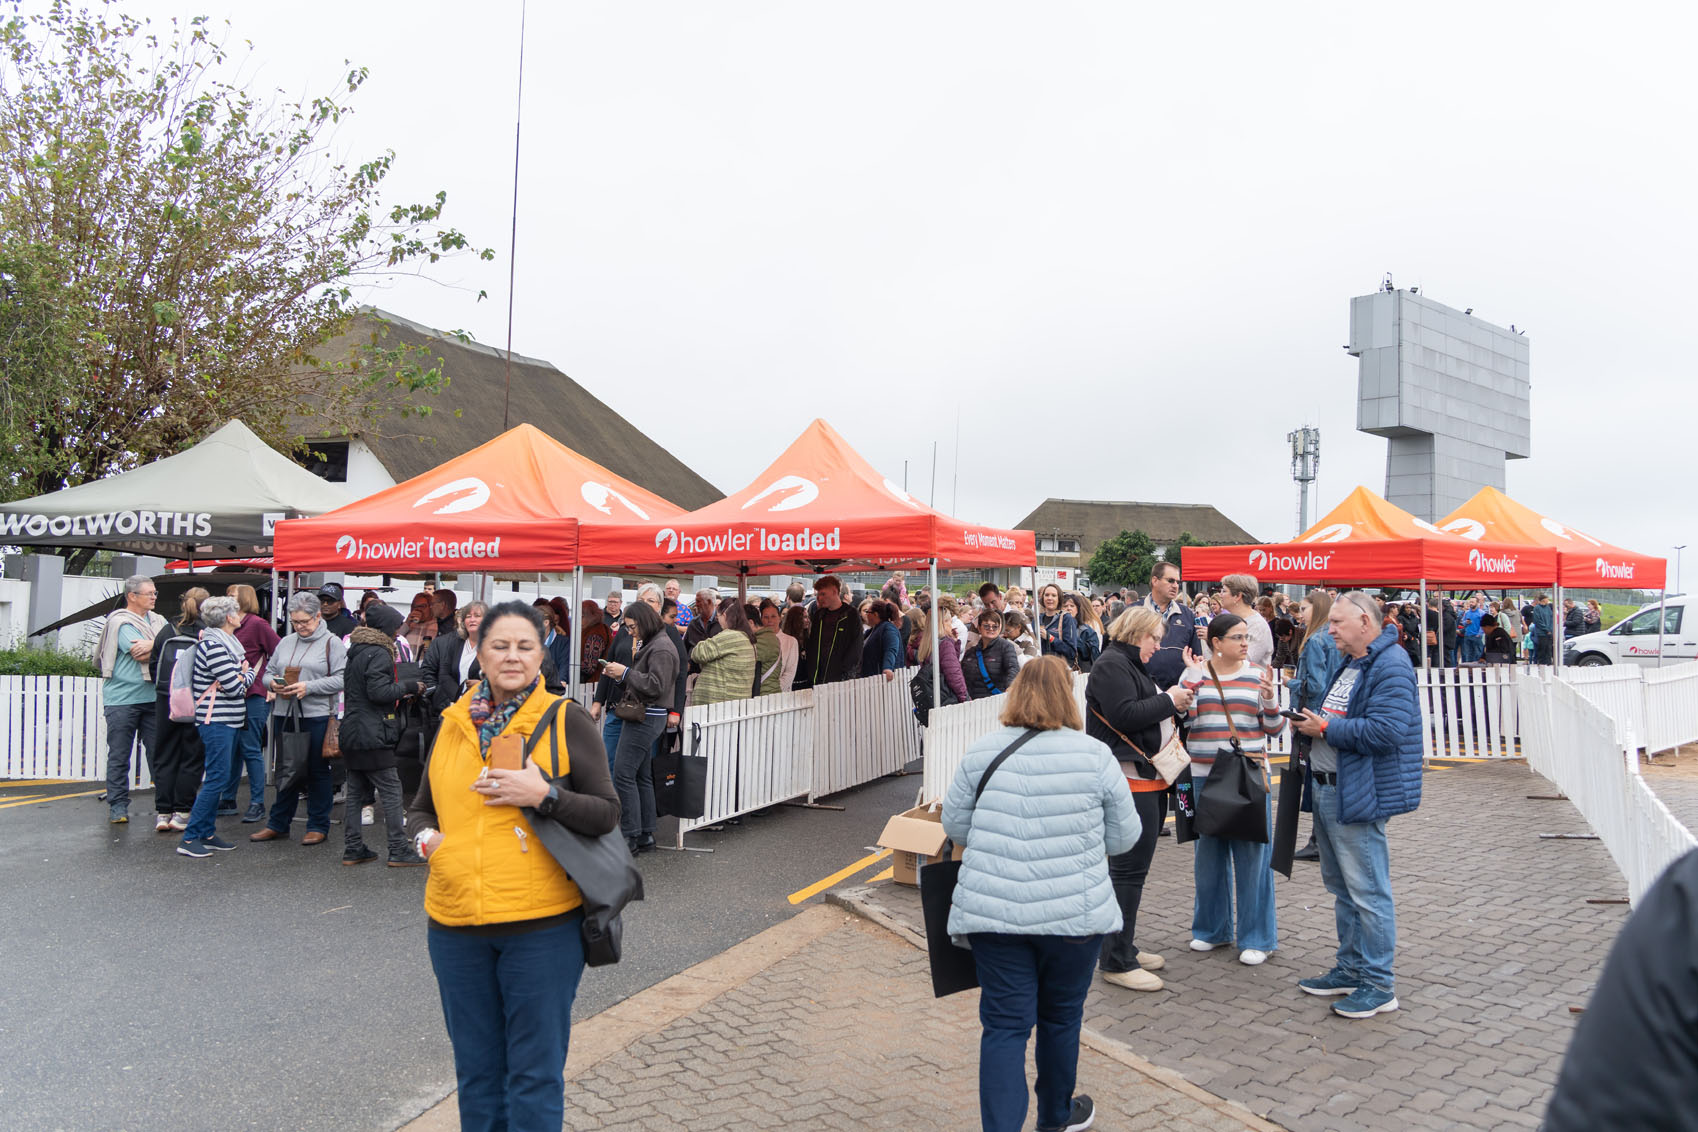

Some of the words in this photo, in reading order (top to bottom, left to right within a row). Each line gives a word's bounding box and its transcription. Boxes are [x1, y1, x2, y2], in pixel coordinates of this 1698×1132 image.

[0, 510, 211, 536] WOOLWORTHS
[429, 536, 501, 559] loaded
[760, 527, 840, 551] loaded
[964, 530, 979, 549] Every
[978, 533, 998, 548] Moment
[998, 535, 1016, 551] Matters
[1638, 647, 1661, 655] howle
